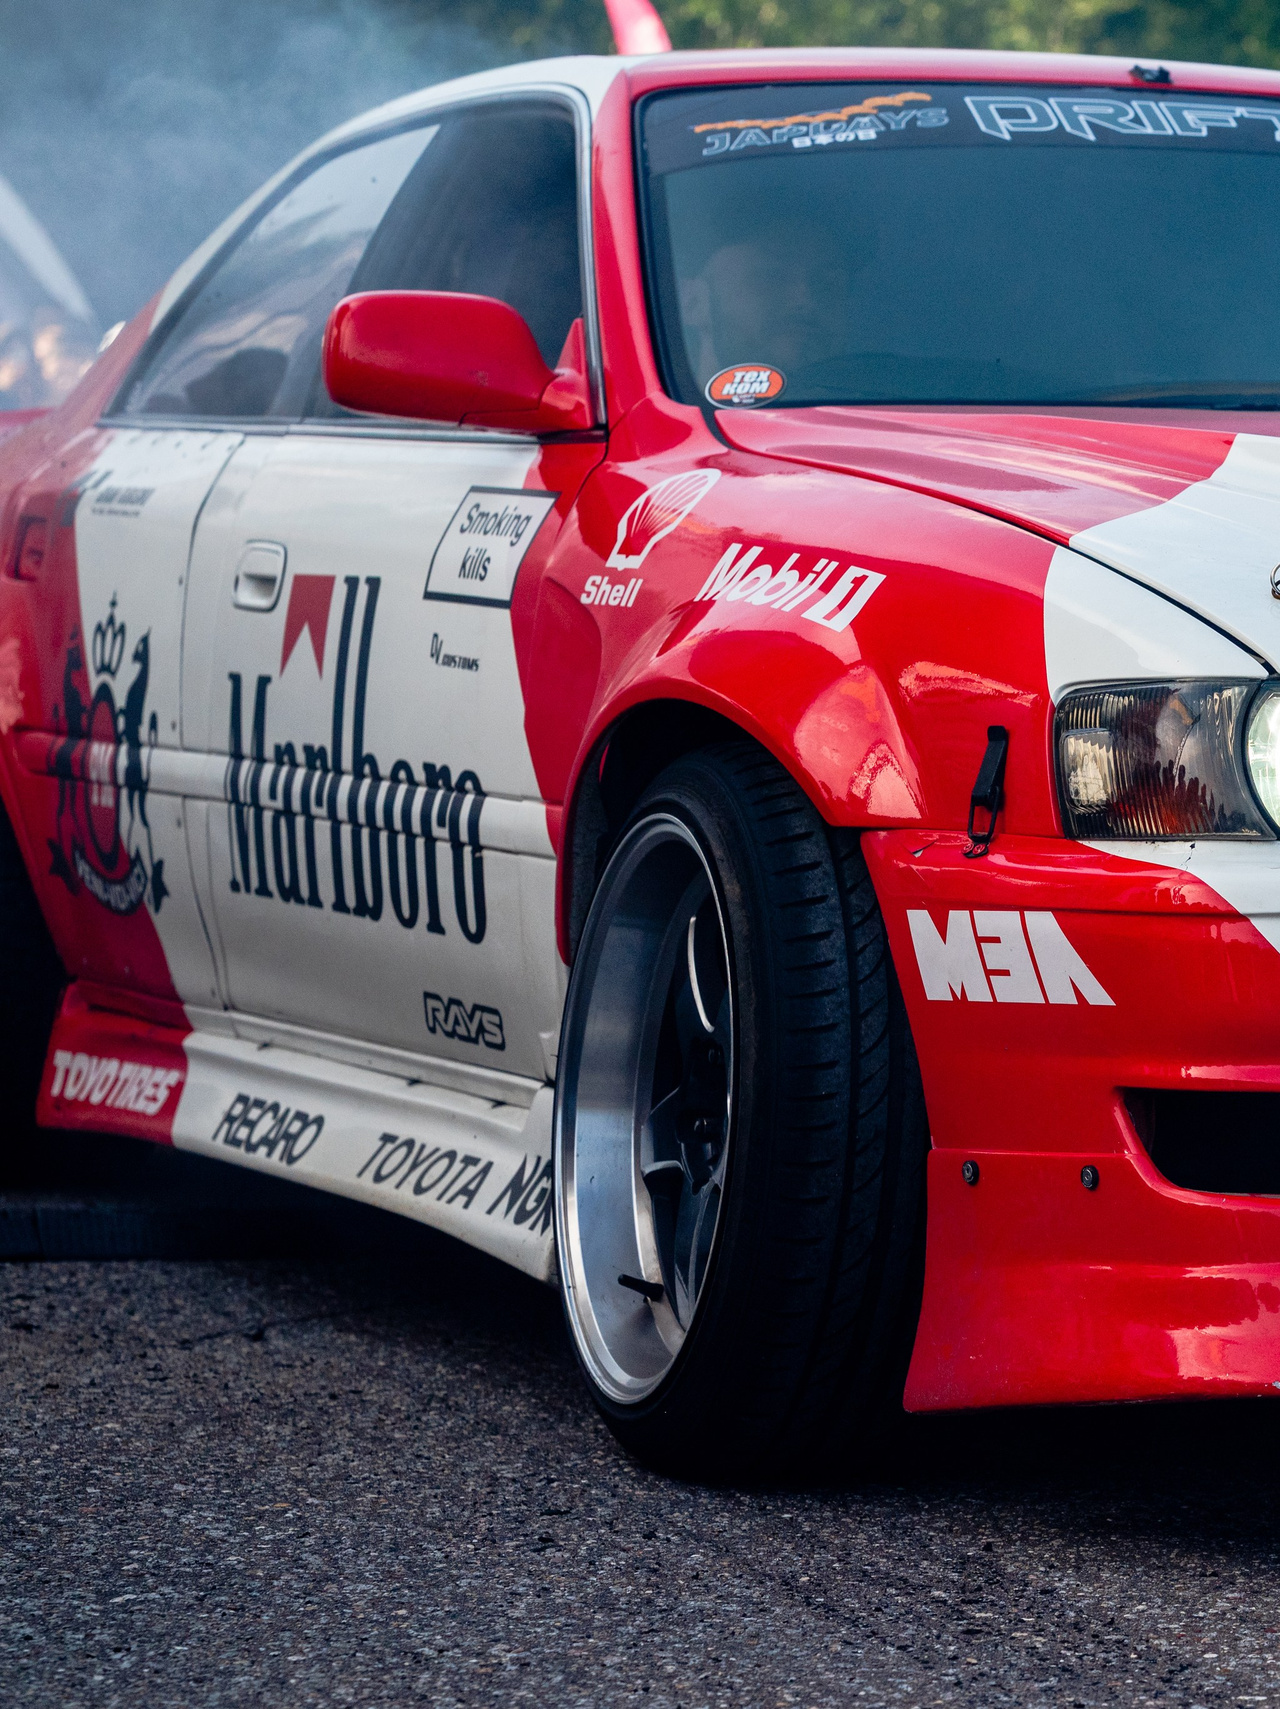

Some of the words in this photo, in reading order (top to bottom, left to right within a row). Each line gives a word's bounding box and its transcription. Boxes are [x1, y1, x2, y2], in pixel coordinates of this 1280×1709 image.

[702, 107, 949, 156] JAPDAYS
[460, 503, 534, 547] Smoking
[458, 547, 492, 583] kills
[580, 574, 644, 608] Shell
[693, 542, 839, 613] Mobil
[225, 576, 487, 945] Marlboro
[423, 991, 506, 1051] RAYS
[212, 1093, 325, 1166] RECARO
[356, 1131, 496, 1210] TOYOTA
